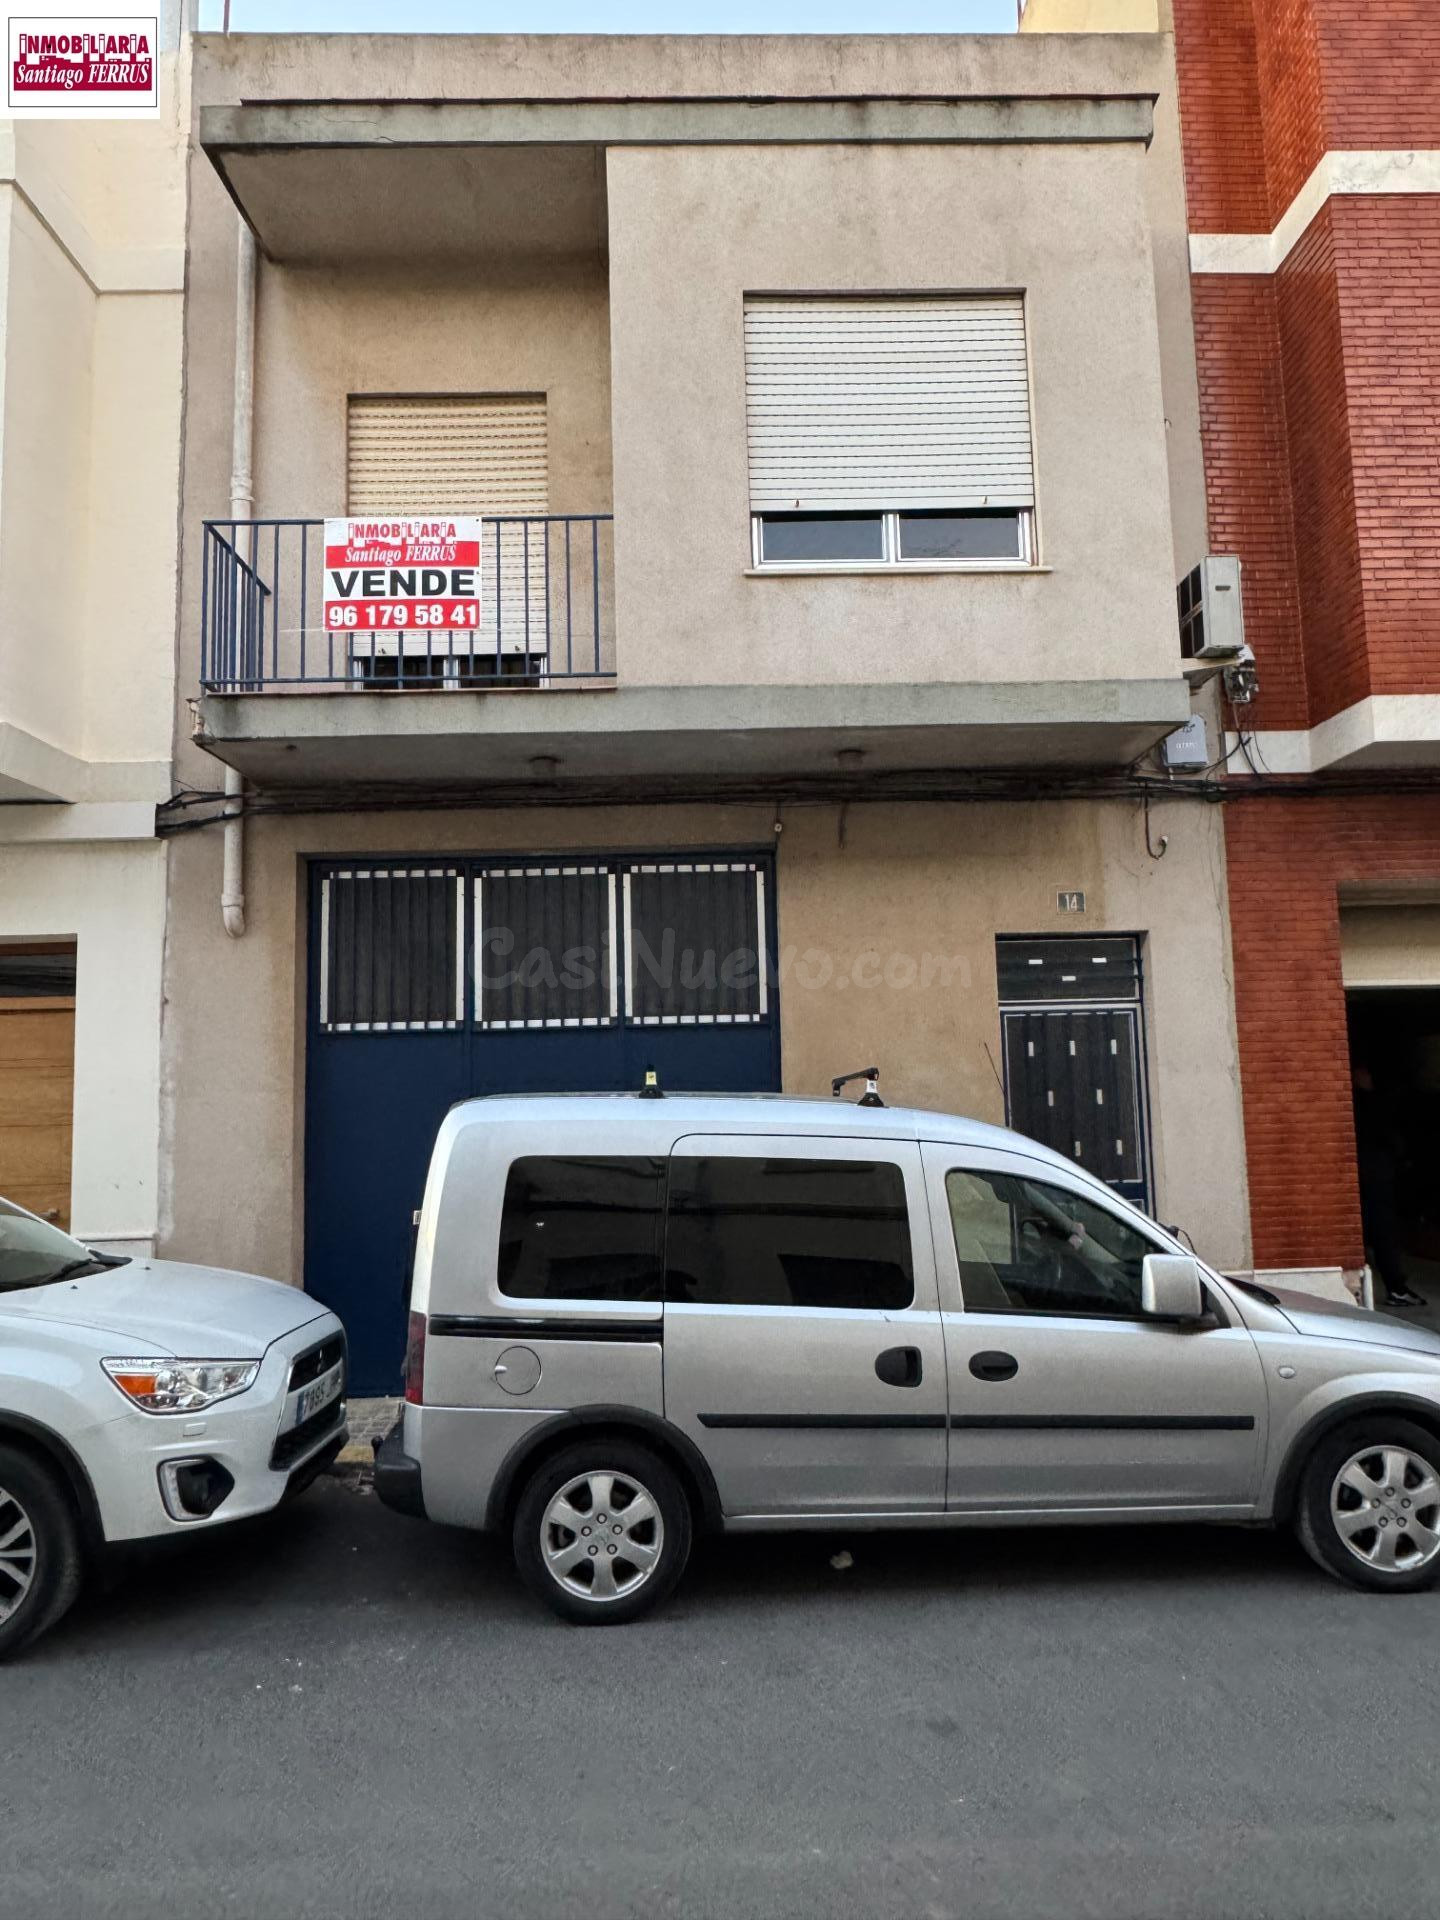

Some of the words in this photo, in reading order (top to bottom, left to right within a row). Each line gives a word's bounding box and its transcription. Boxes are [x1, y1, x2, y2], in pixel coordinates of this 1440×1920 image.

[345, 547, 401, 567] Santiago
[331, 569, 476, 598] VENDE
[329, 606, 358, 627] 96
[365, 604, 409, 626] 179
[414, 604, 444, 626] 58
[450, 604, 477, 625] 41
[1065, 893, 1078, 911] 14
